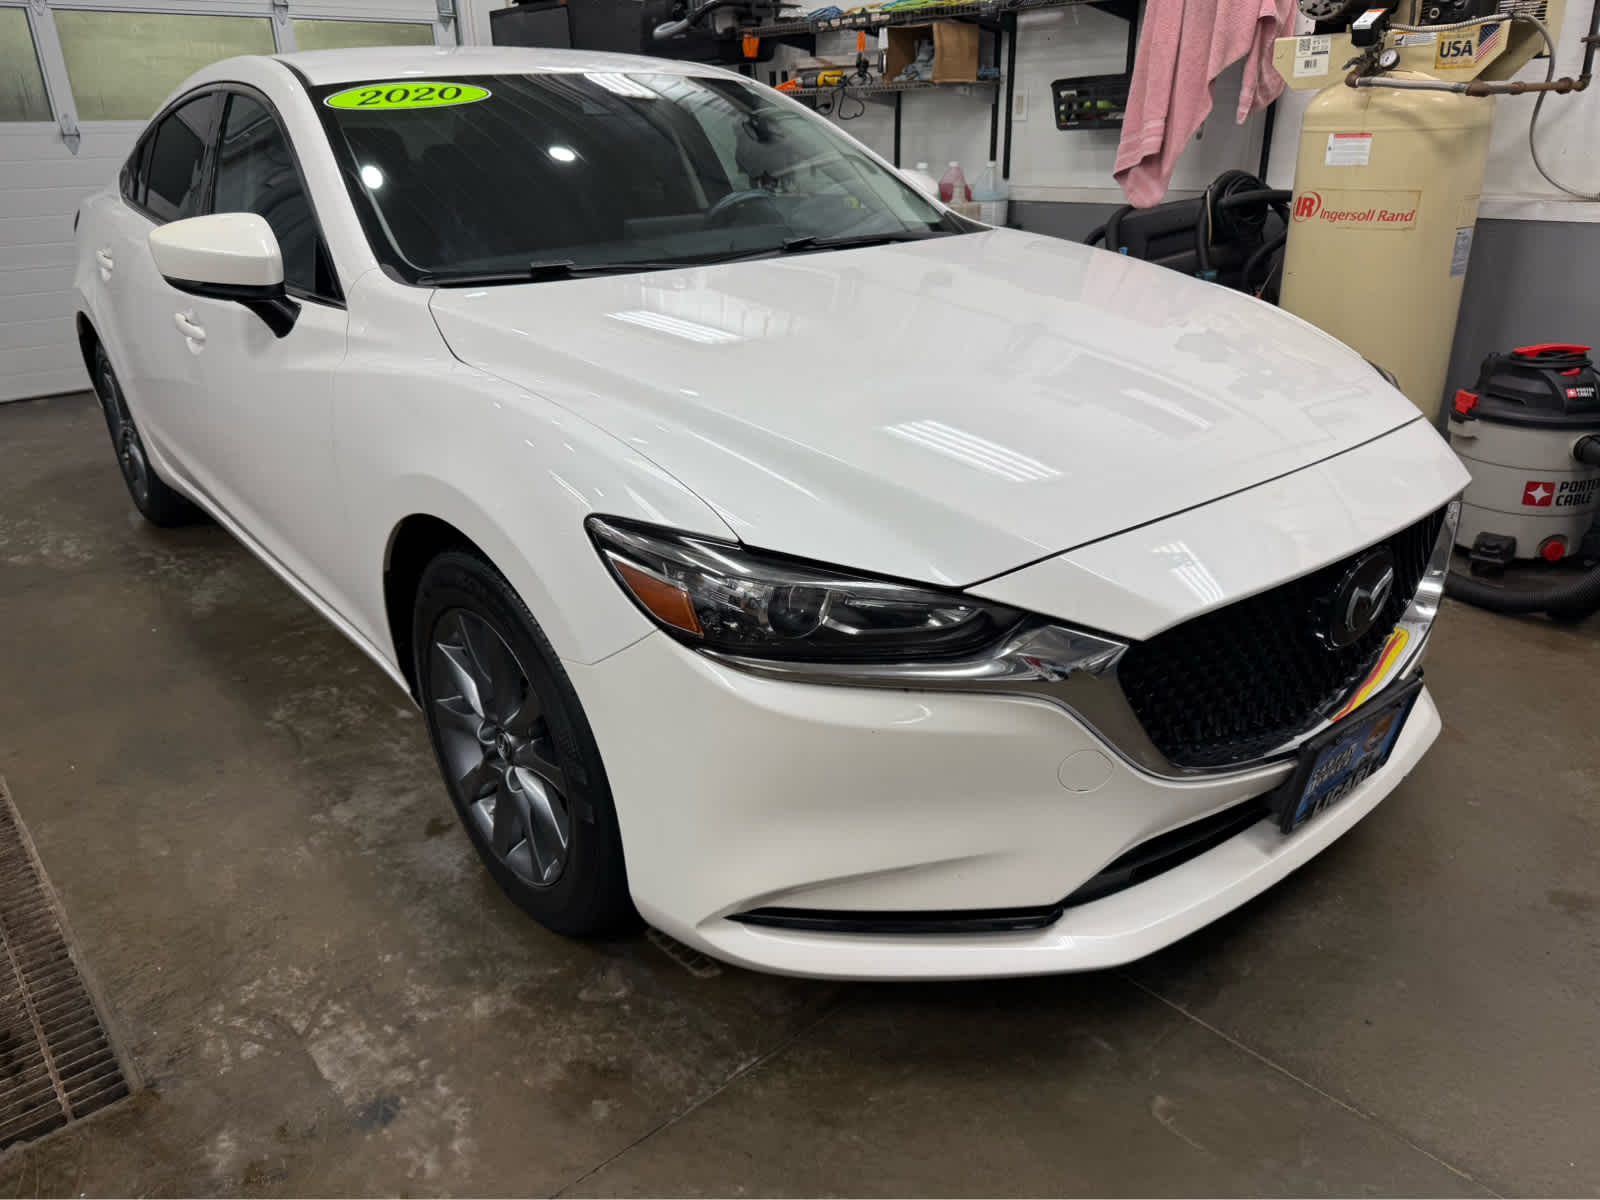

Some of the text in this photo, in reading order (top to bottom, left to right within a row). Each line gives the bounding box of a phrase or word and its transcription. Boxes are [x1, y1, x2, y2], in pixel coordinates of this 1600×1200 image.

[1439, 39, 1473, 58] USA
[357, 87, 462, 106] 2020
[1295, 196, 1315, 217] IR
[1320, 207, 1416, 223] Ingersoll Rand
[1555, 492, 1592, 506] CABLE
